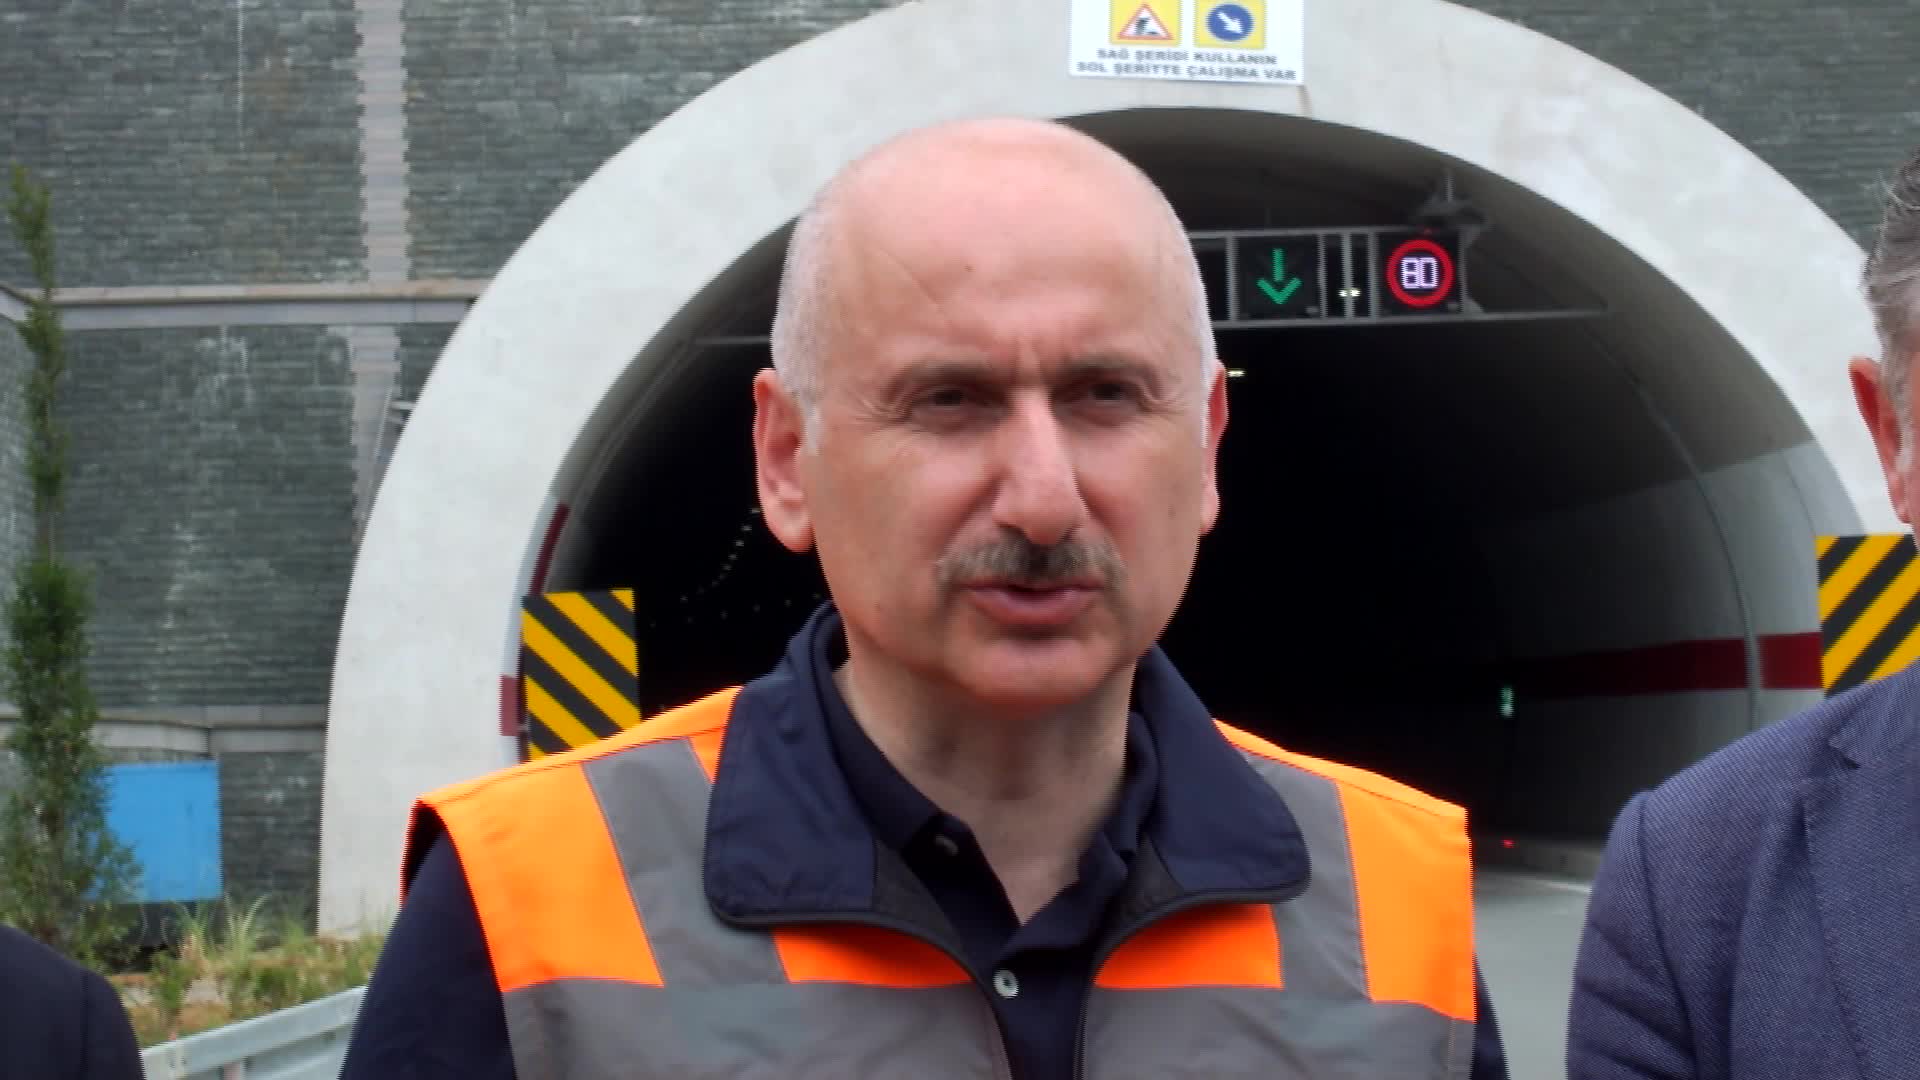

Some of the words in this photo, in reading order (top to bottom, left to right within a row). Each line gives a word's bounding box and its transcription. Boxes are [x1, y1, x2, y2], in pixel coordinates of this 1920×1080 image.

[1097, 48, 1129, 60] SAĞ
[1194, 53, 1277, 65] KULLANIN
[1077, 62, 1107, 72] SOL
[1187, 65, 1258, 79] ÇALIŞMA
[1263, 70, 1297, 81] VAR
[1401, 257, 1439, 289] 80
